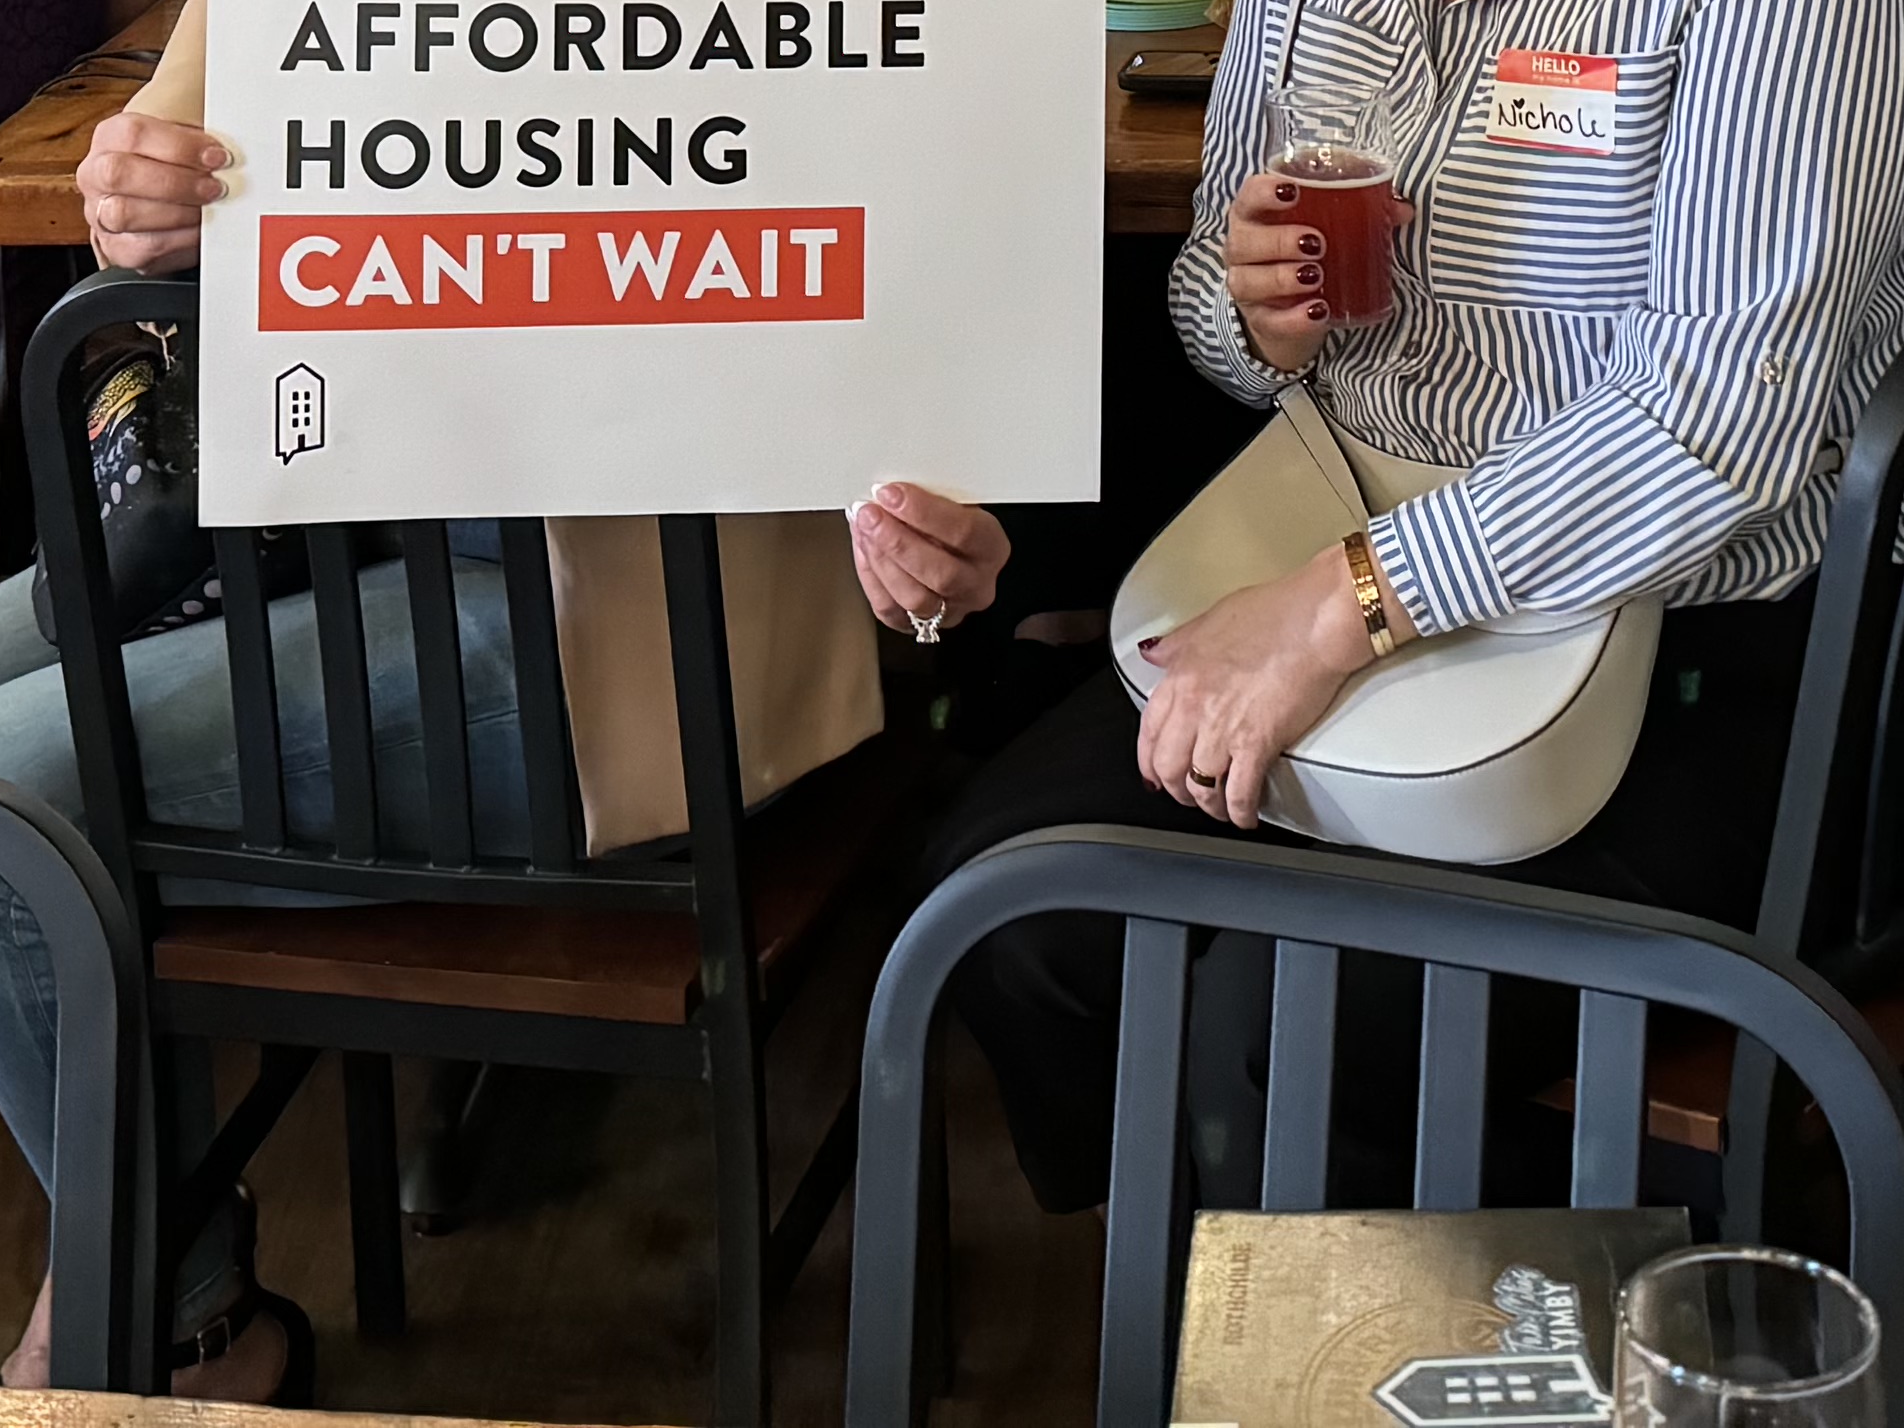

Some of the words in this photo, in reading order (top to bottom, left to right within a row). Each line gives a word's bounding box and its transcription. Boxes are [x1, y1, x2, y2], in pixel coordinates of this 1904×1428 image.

[279, 0, 928, 73] AFFORDABLE
[1531, 55, 1581, 76] HELLO
[284, 115, 750, 190] HOUSING
[278, 232, 567, 310] CAN'T
[596, 227, 840, 303] WAIT
[1543, 1280, 1581, 1352] YIMBY
